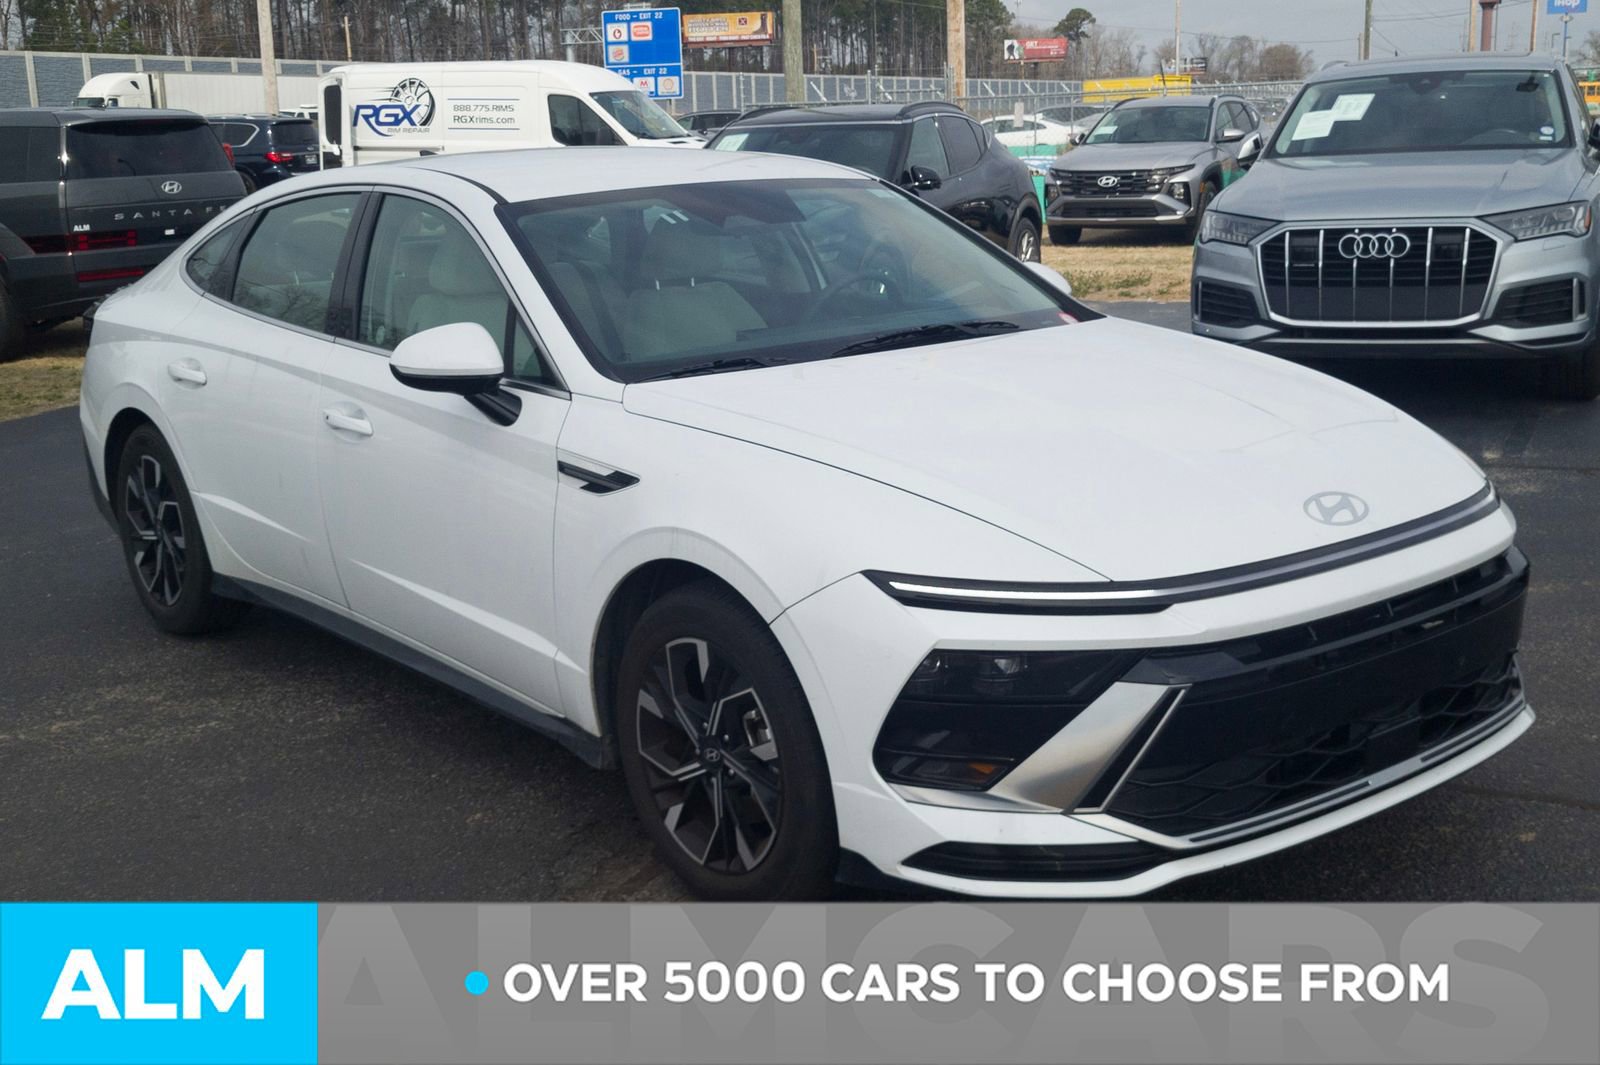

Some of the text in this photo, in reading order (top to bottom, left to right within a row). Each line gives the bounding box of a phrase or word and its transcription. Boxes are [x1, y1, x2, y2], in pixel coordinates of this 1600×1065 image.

[353, 104, 421, 136] RGX
[453, 115, 515, 124] RGXrims.com
[114, 208, 193, 220] SANTA
[73, 224, 91, 232] ALM
